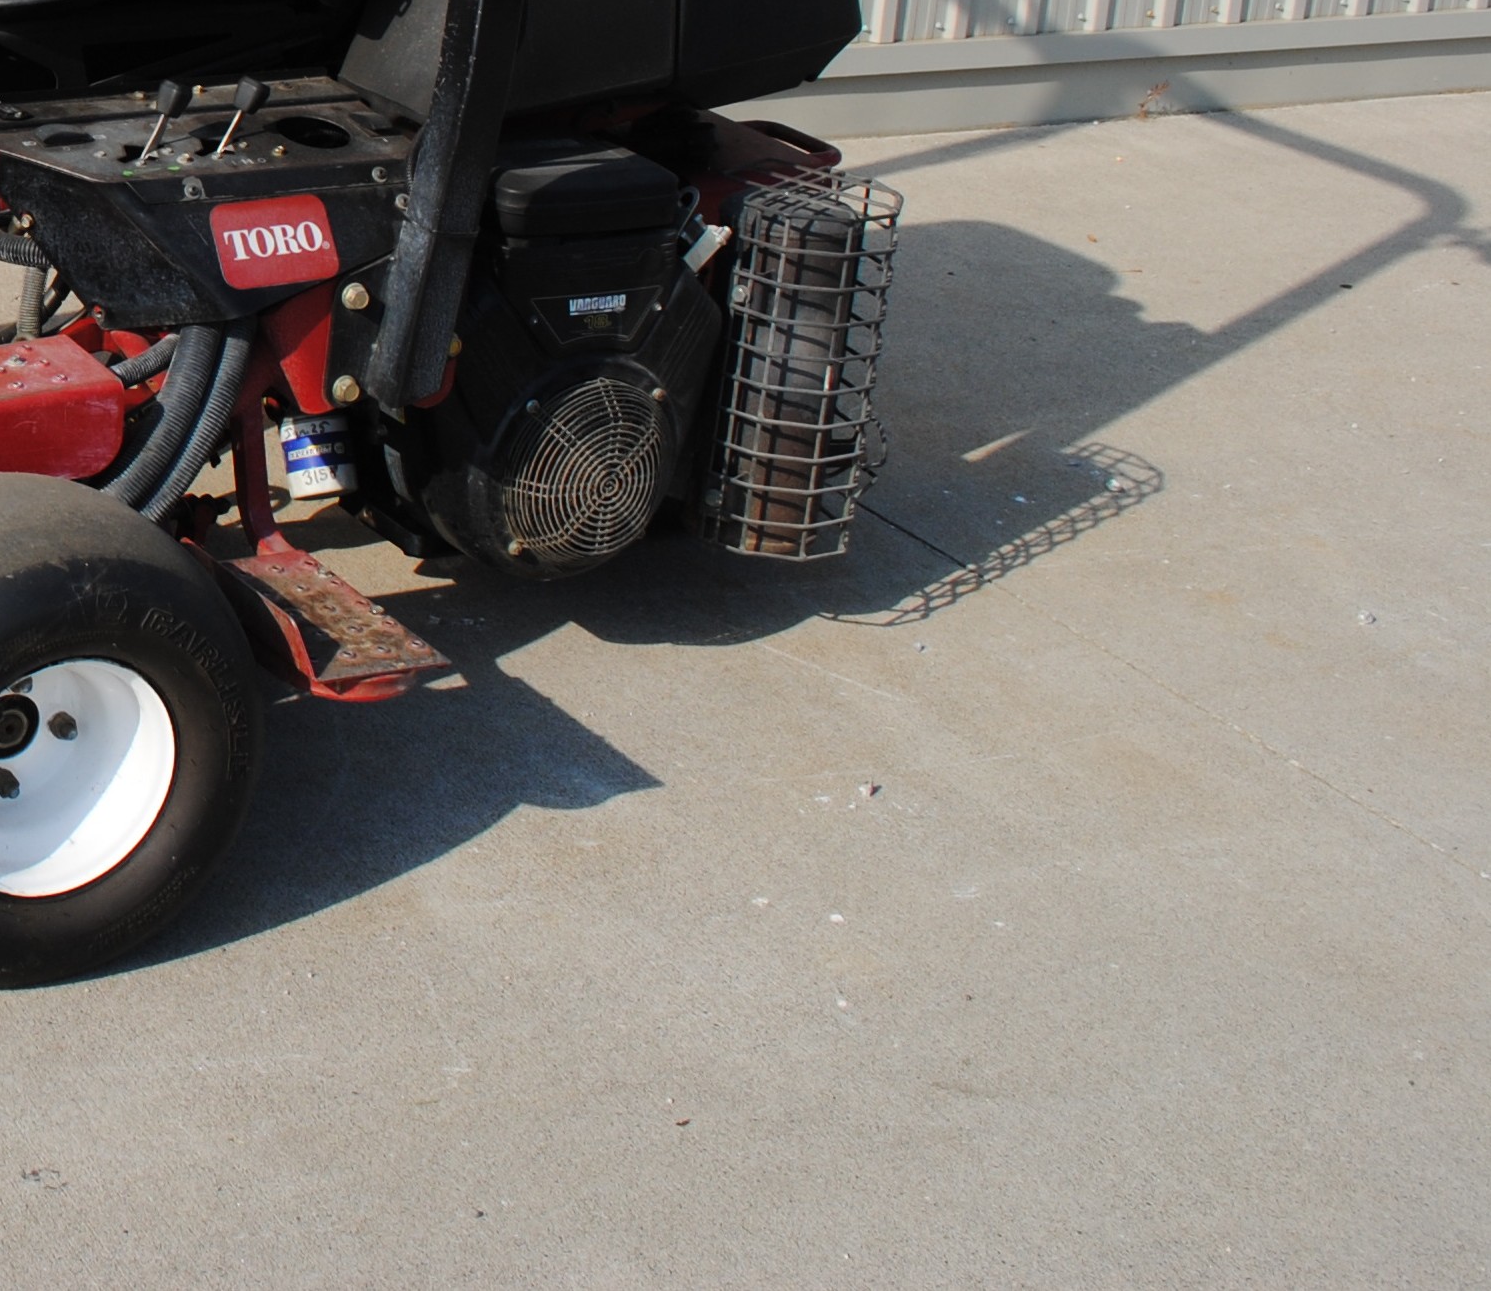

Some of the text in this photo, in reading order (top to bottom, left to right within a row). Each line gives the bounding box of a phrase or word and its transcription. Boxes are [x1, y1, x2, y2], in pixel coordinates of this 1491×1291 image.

[223, 221, 323, 261] TORO
[569, 294, 627, 312] VANGUARD
[142, 606, 250, 780] CARLISLE
